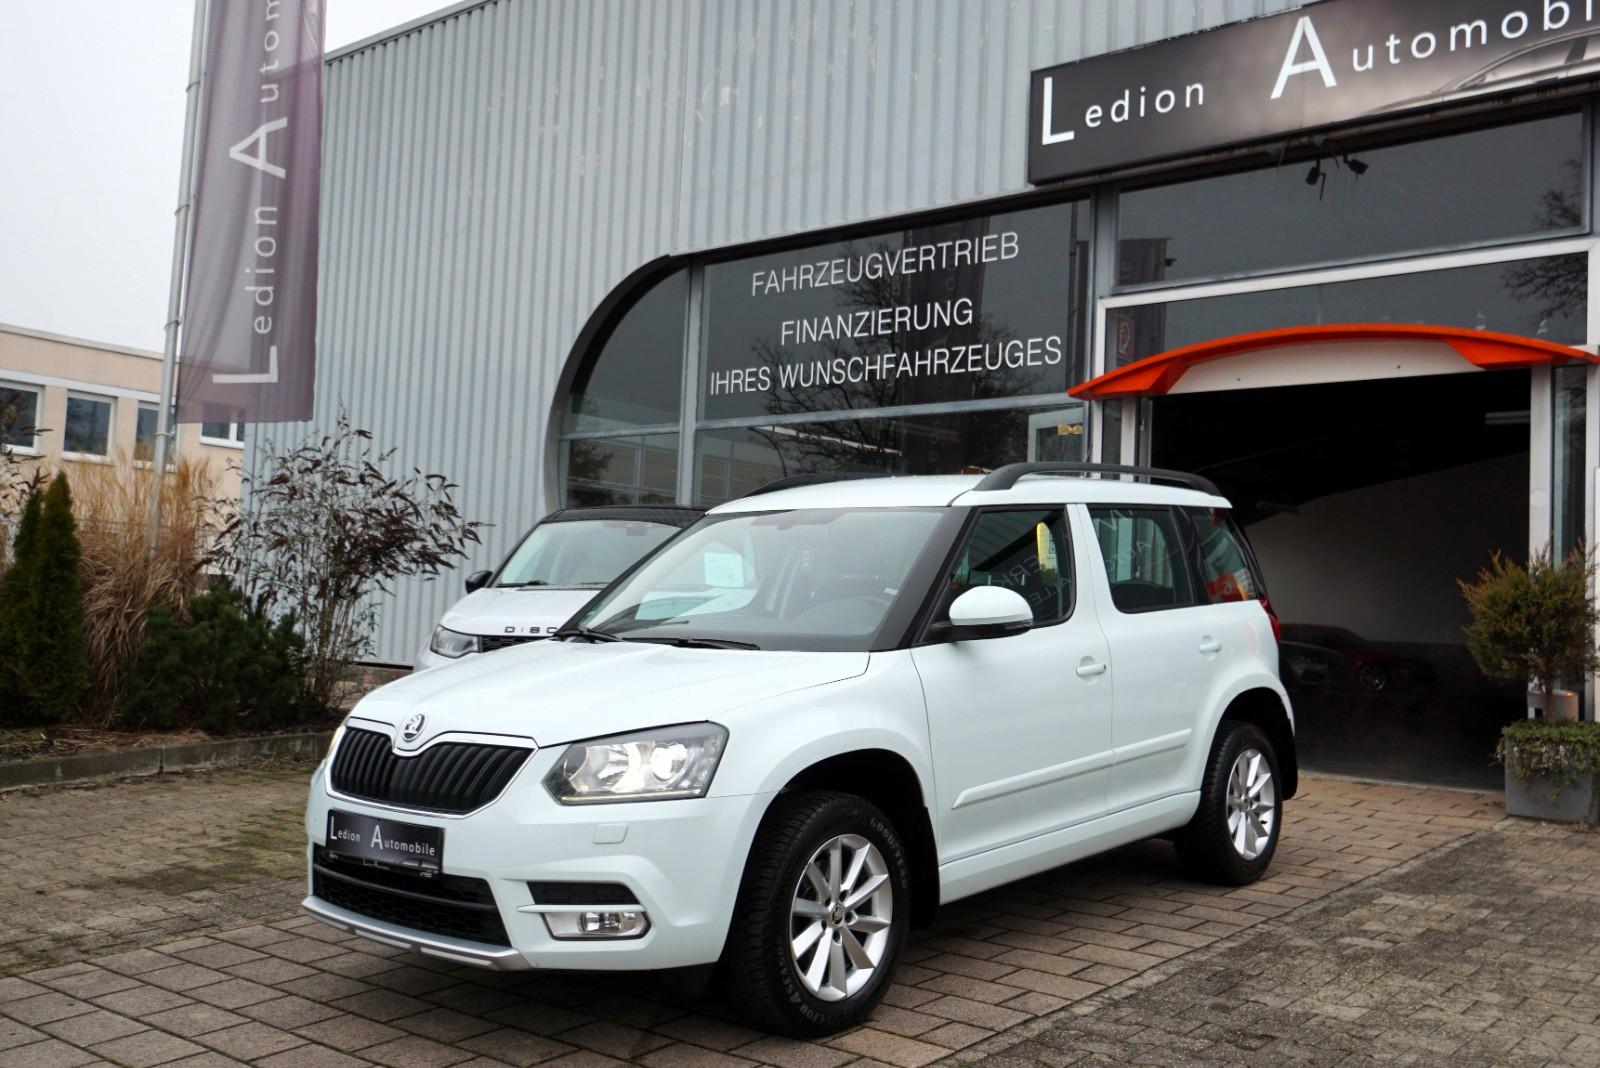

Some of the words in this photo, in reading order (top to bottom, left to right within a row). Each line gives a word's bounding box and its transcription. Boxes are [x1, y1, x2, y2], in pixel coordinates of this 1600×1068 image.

[1041, 76, 1206, 146] Ledion
[212, 206, 279, 384] Ledion
[751, 231, 1020, 297] FAHRZEUGVERTRIEB
[780, 297, 973, 346] FINANZIERUNG
[710, 366, 771, 396] IHRES
[779, 335, 1063, 390] WUNSCHFAHRZEUGES
[330, 815, 361, 842] Ledion
[370, 824, 436, 856] Automobile
